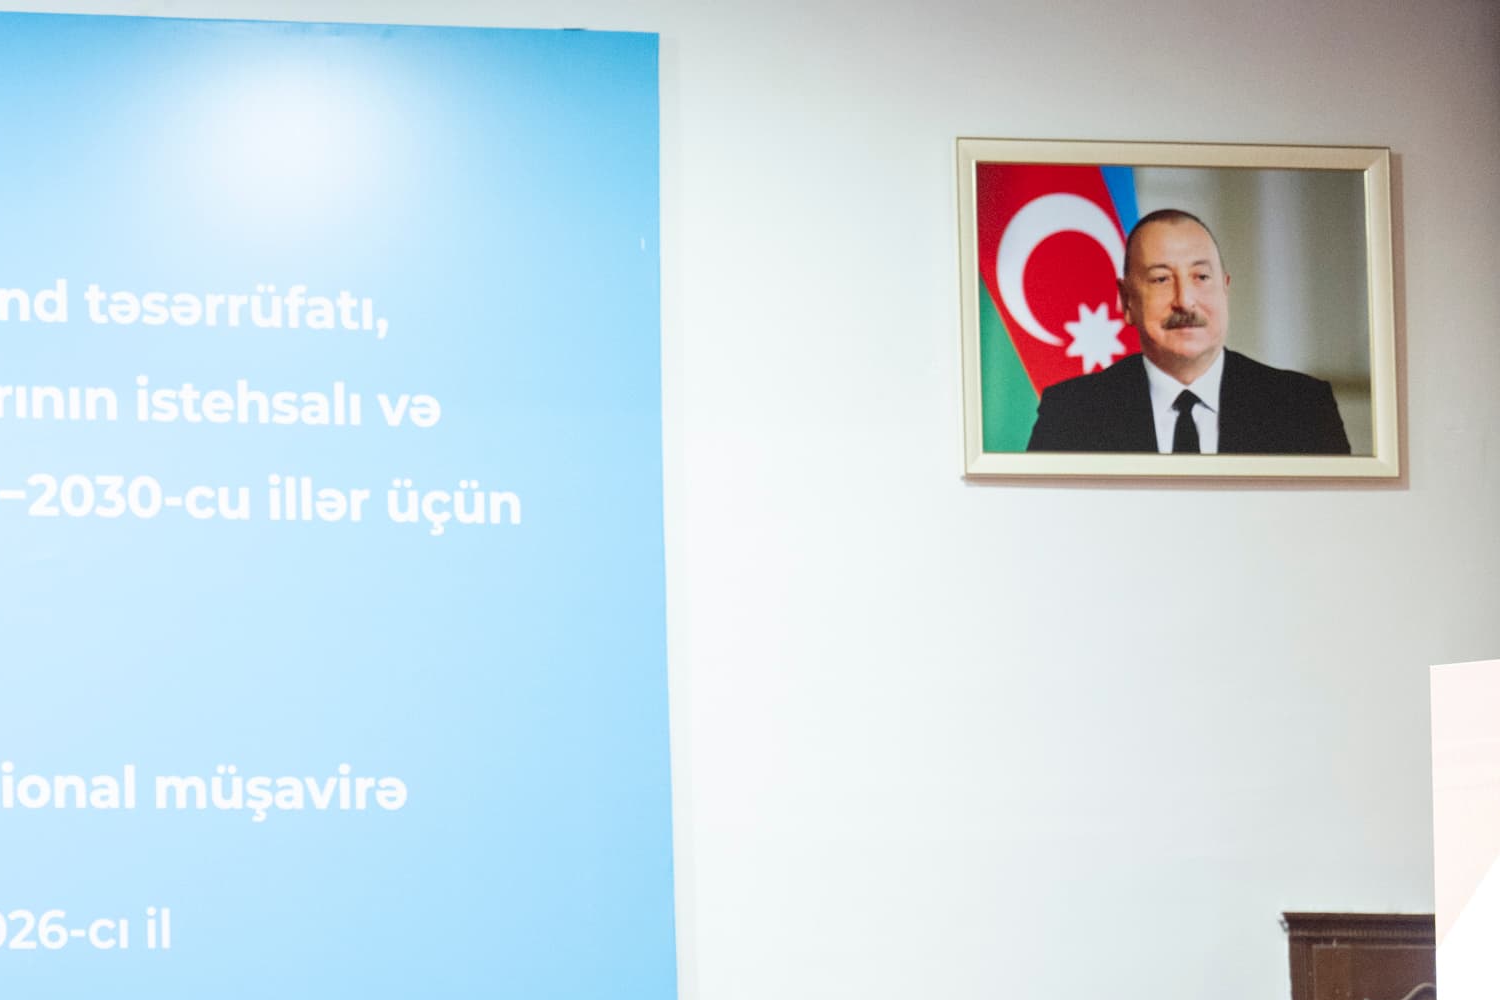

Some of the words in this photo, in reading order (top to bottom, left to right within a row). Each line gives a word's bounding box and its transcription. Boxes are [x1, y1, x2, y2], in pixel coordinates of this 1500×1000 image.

[84, 284, 389, 338] təsərrüfatı,
[137, 376, 361, 425] istehsalı
[377, 394, 441, 427] və
[269, 474, 370, 522] illər
[388, 478, 521, 536] üçün
[156, 763, 407, 822] müşavirə
[147, 906, 170, 949] il
